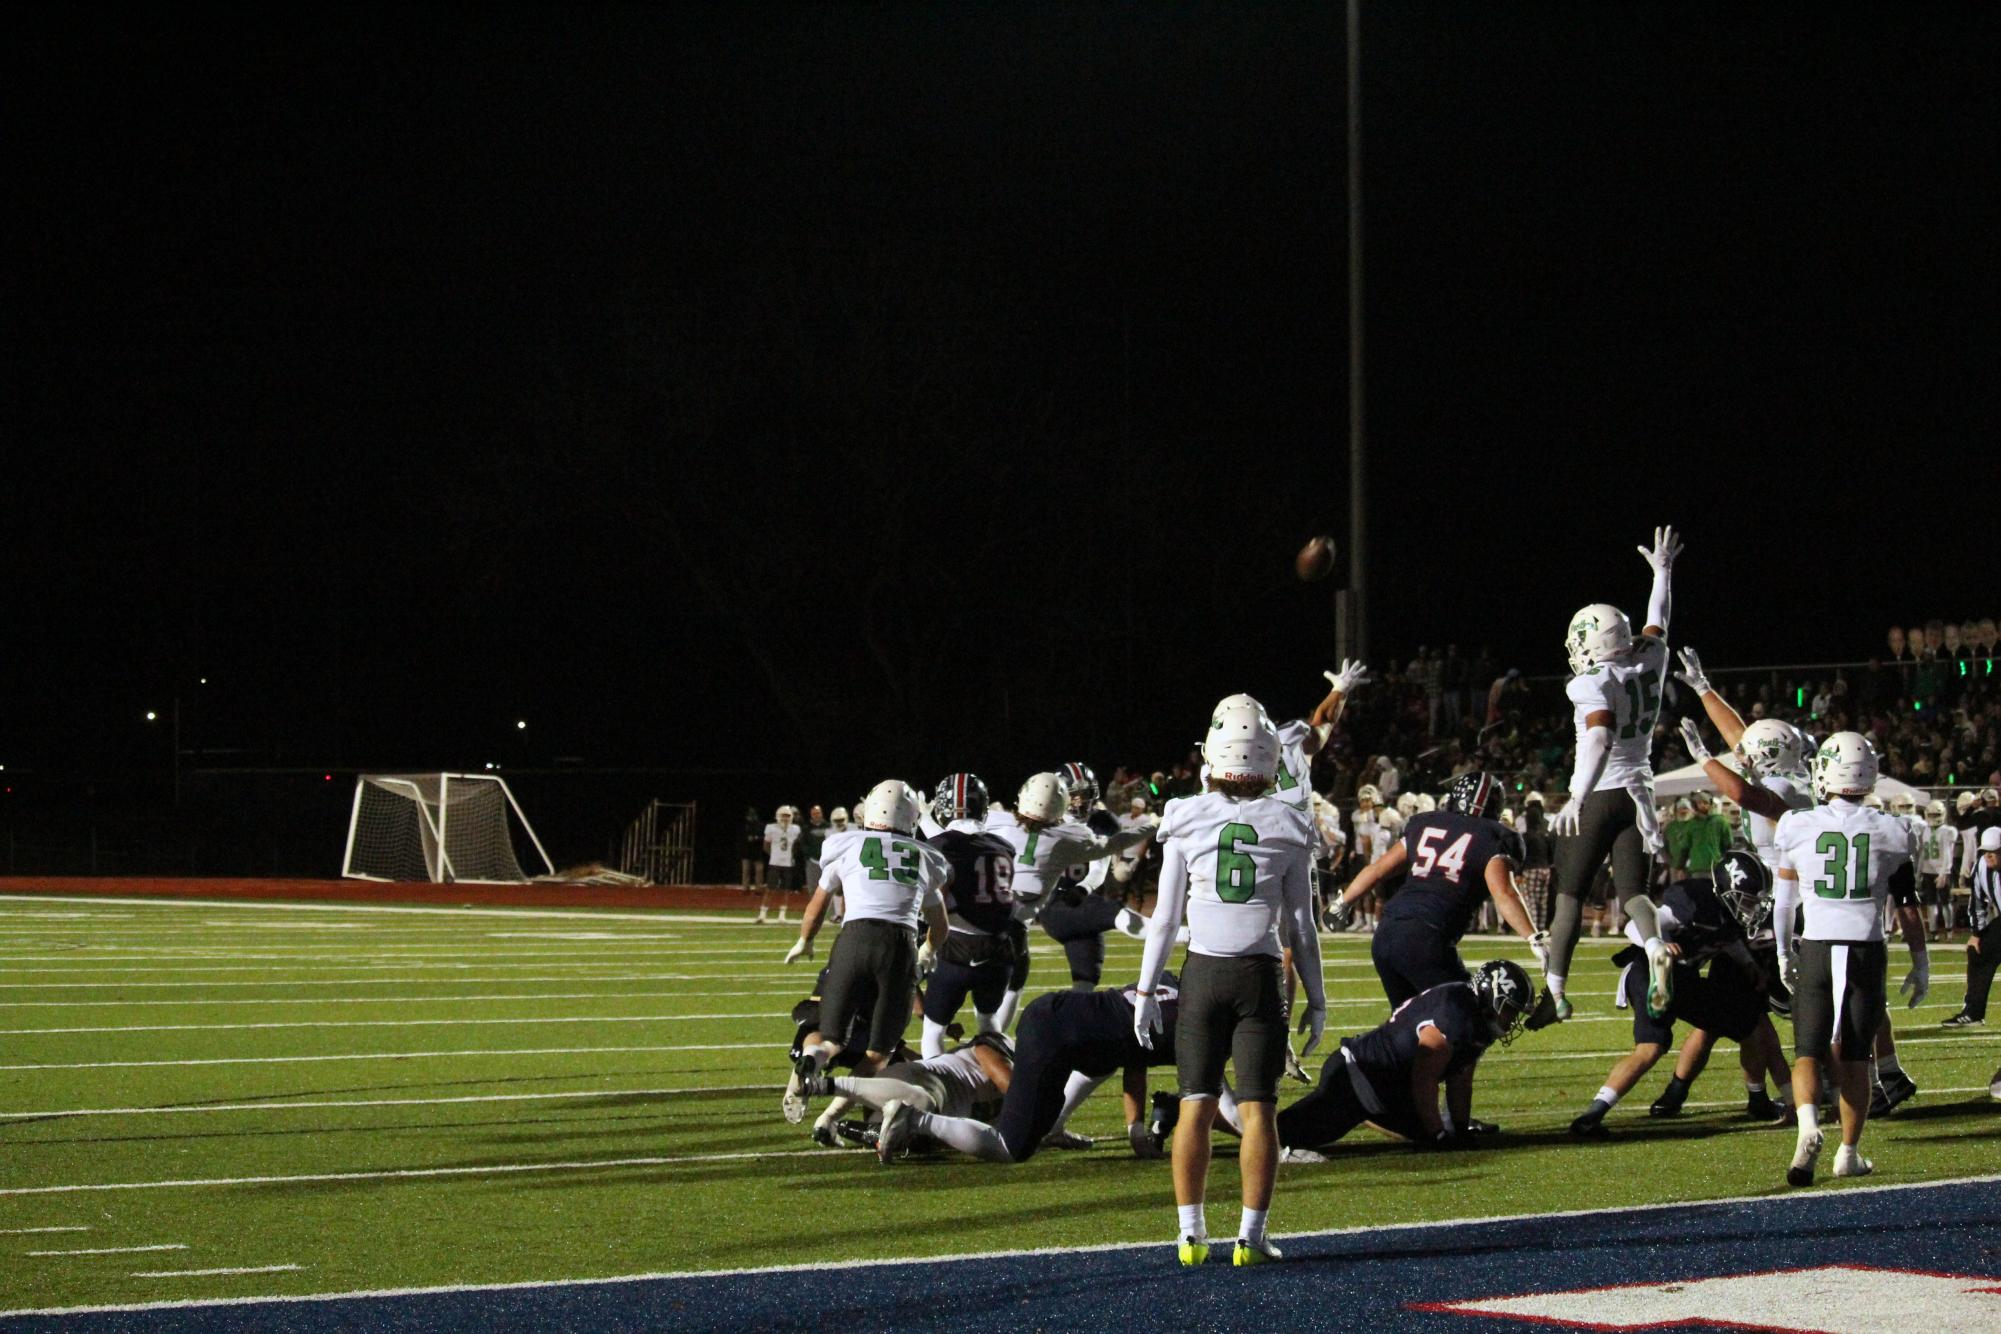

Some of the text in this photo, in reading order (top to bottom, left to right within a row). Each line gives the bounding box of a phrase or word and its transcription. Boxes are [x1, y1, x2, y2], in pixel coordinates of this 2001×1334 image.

[859, 837, 921, 886] 43
[1215, 822, 1259, 904] 6
[1411, 826, 1474, 884] 54
[1813, 832, 1871, 899] 31
